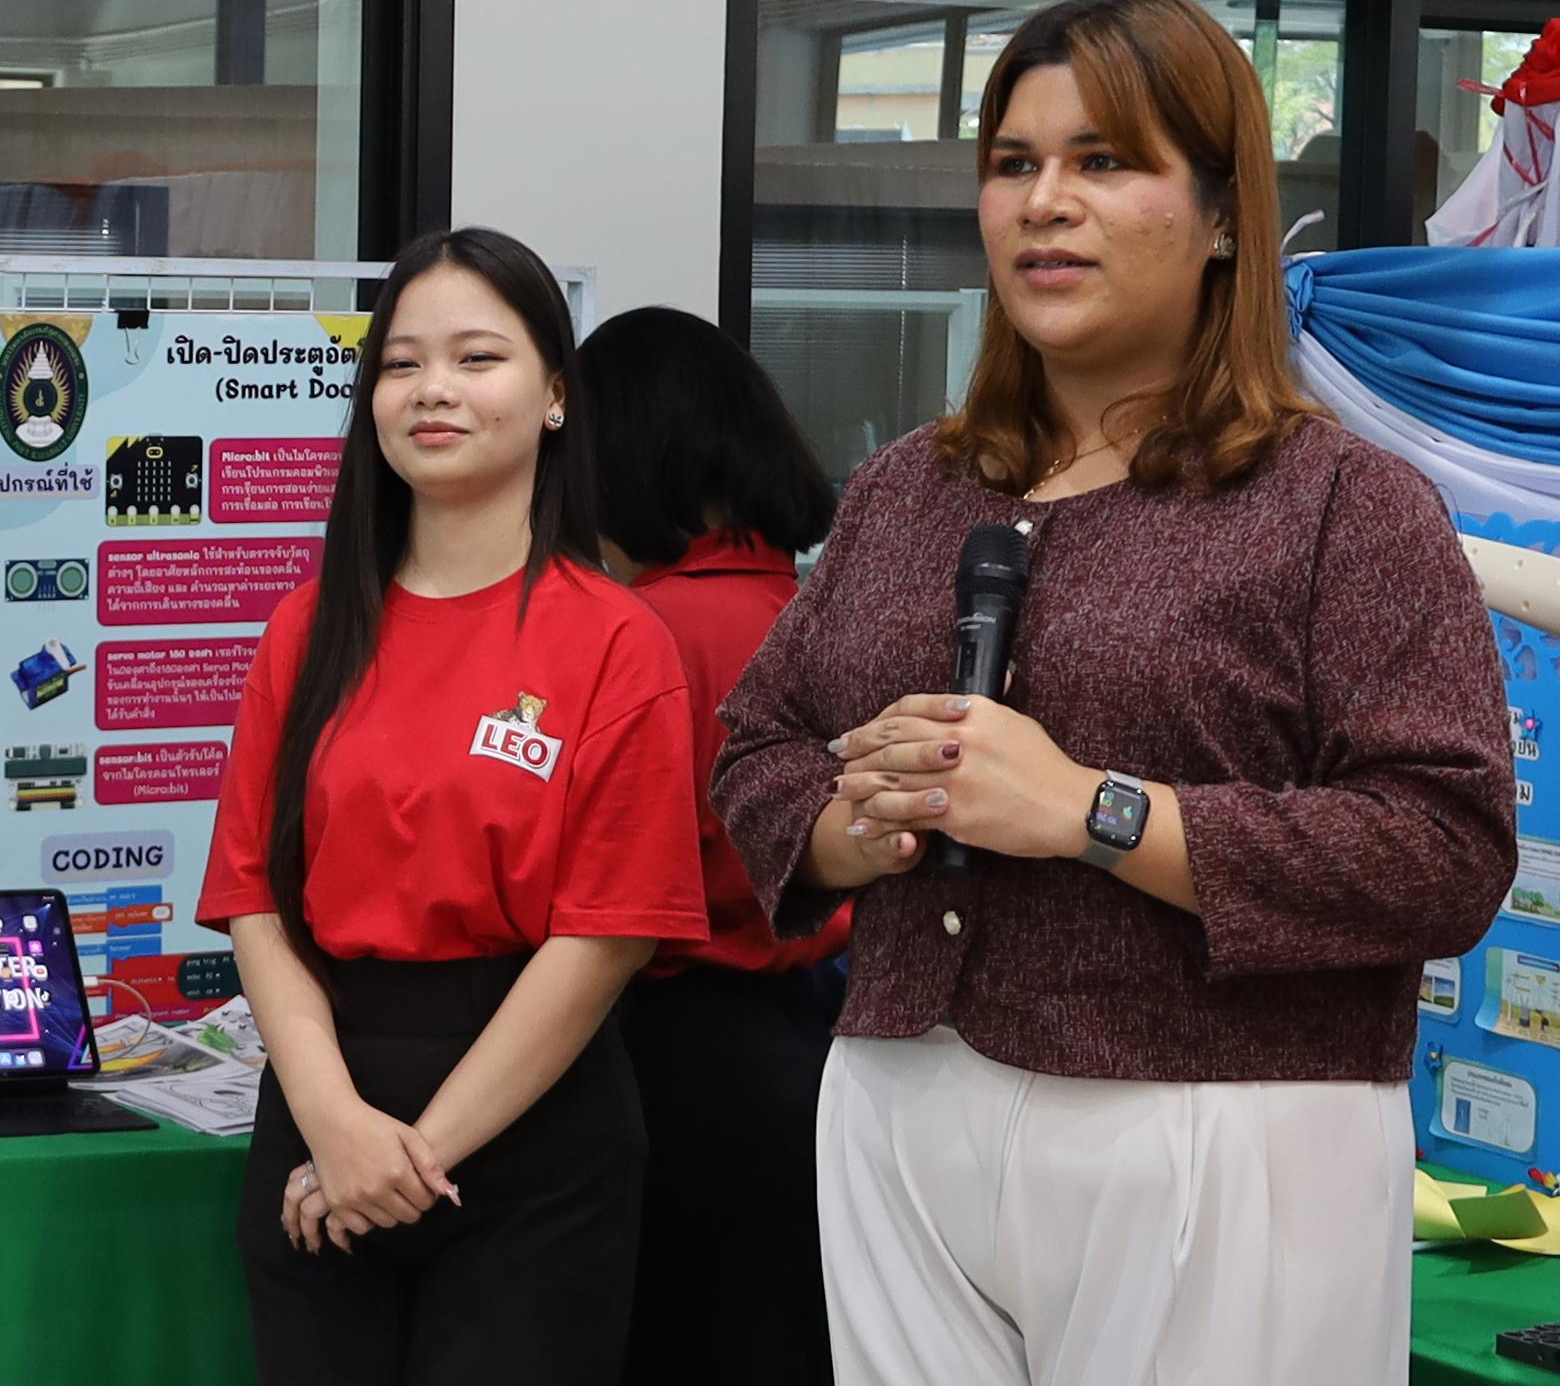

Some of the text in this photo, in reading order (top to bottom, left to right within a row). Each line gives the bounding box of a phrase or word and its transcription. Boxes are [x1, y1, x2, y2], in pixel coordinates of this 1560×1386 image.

[166, 335, 364, 376] เปิด-ปิดประตูอัต
[215, 378, 298, 403] (Smart
[481, 724, 548, 766] LEO
[52, 845, 164, 872] CODING
